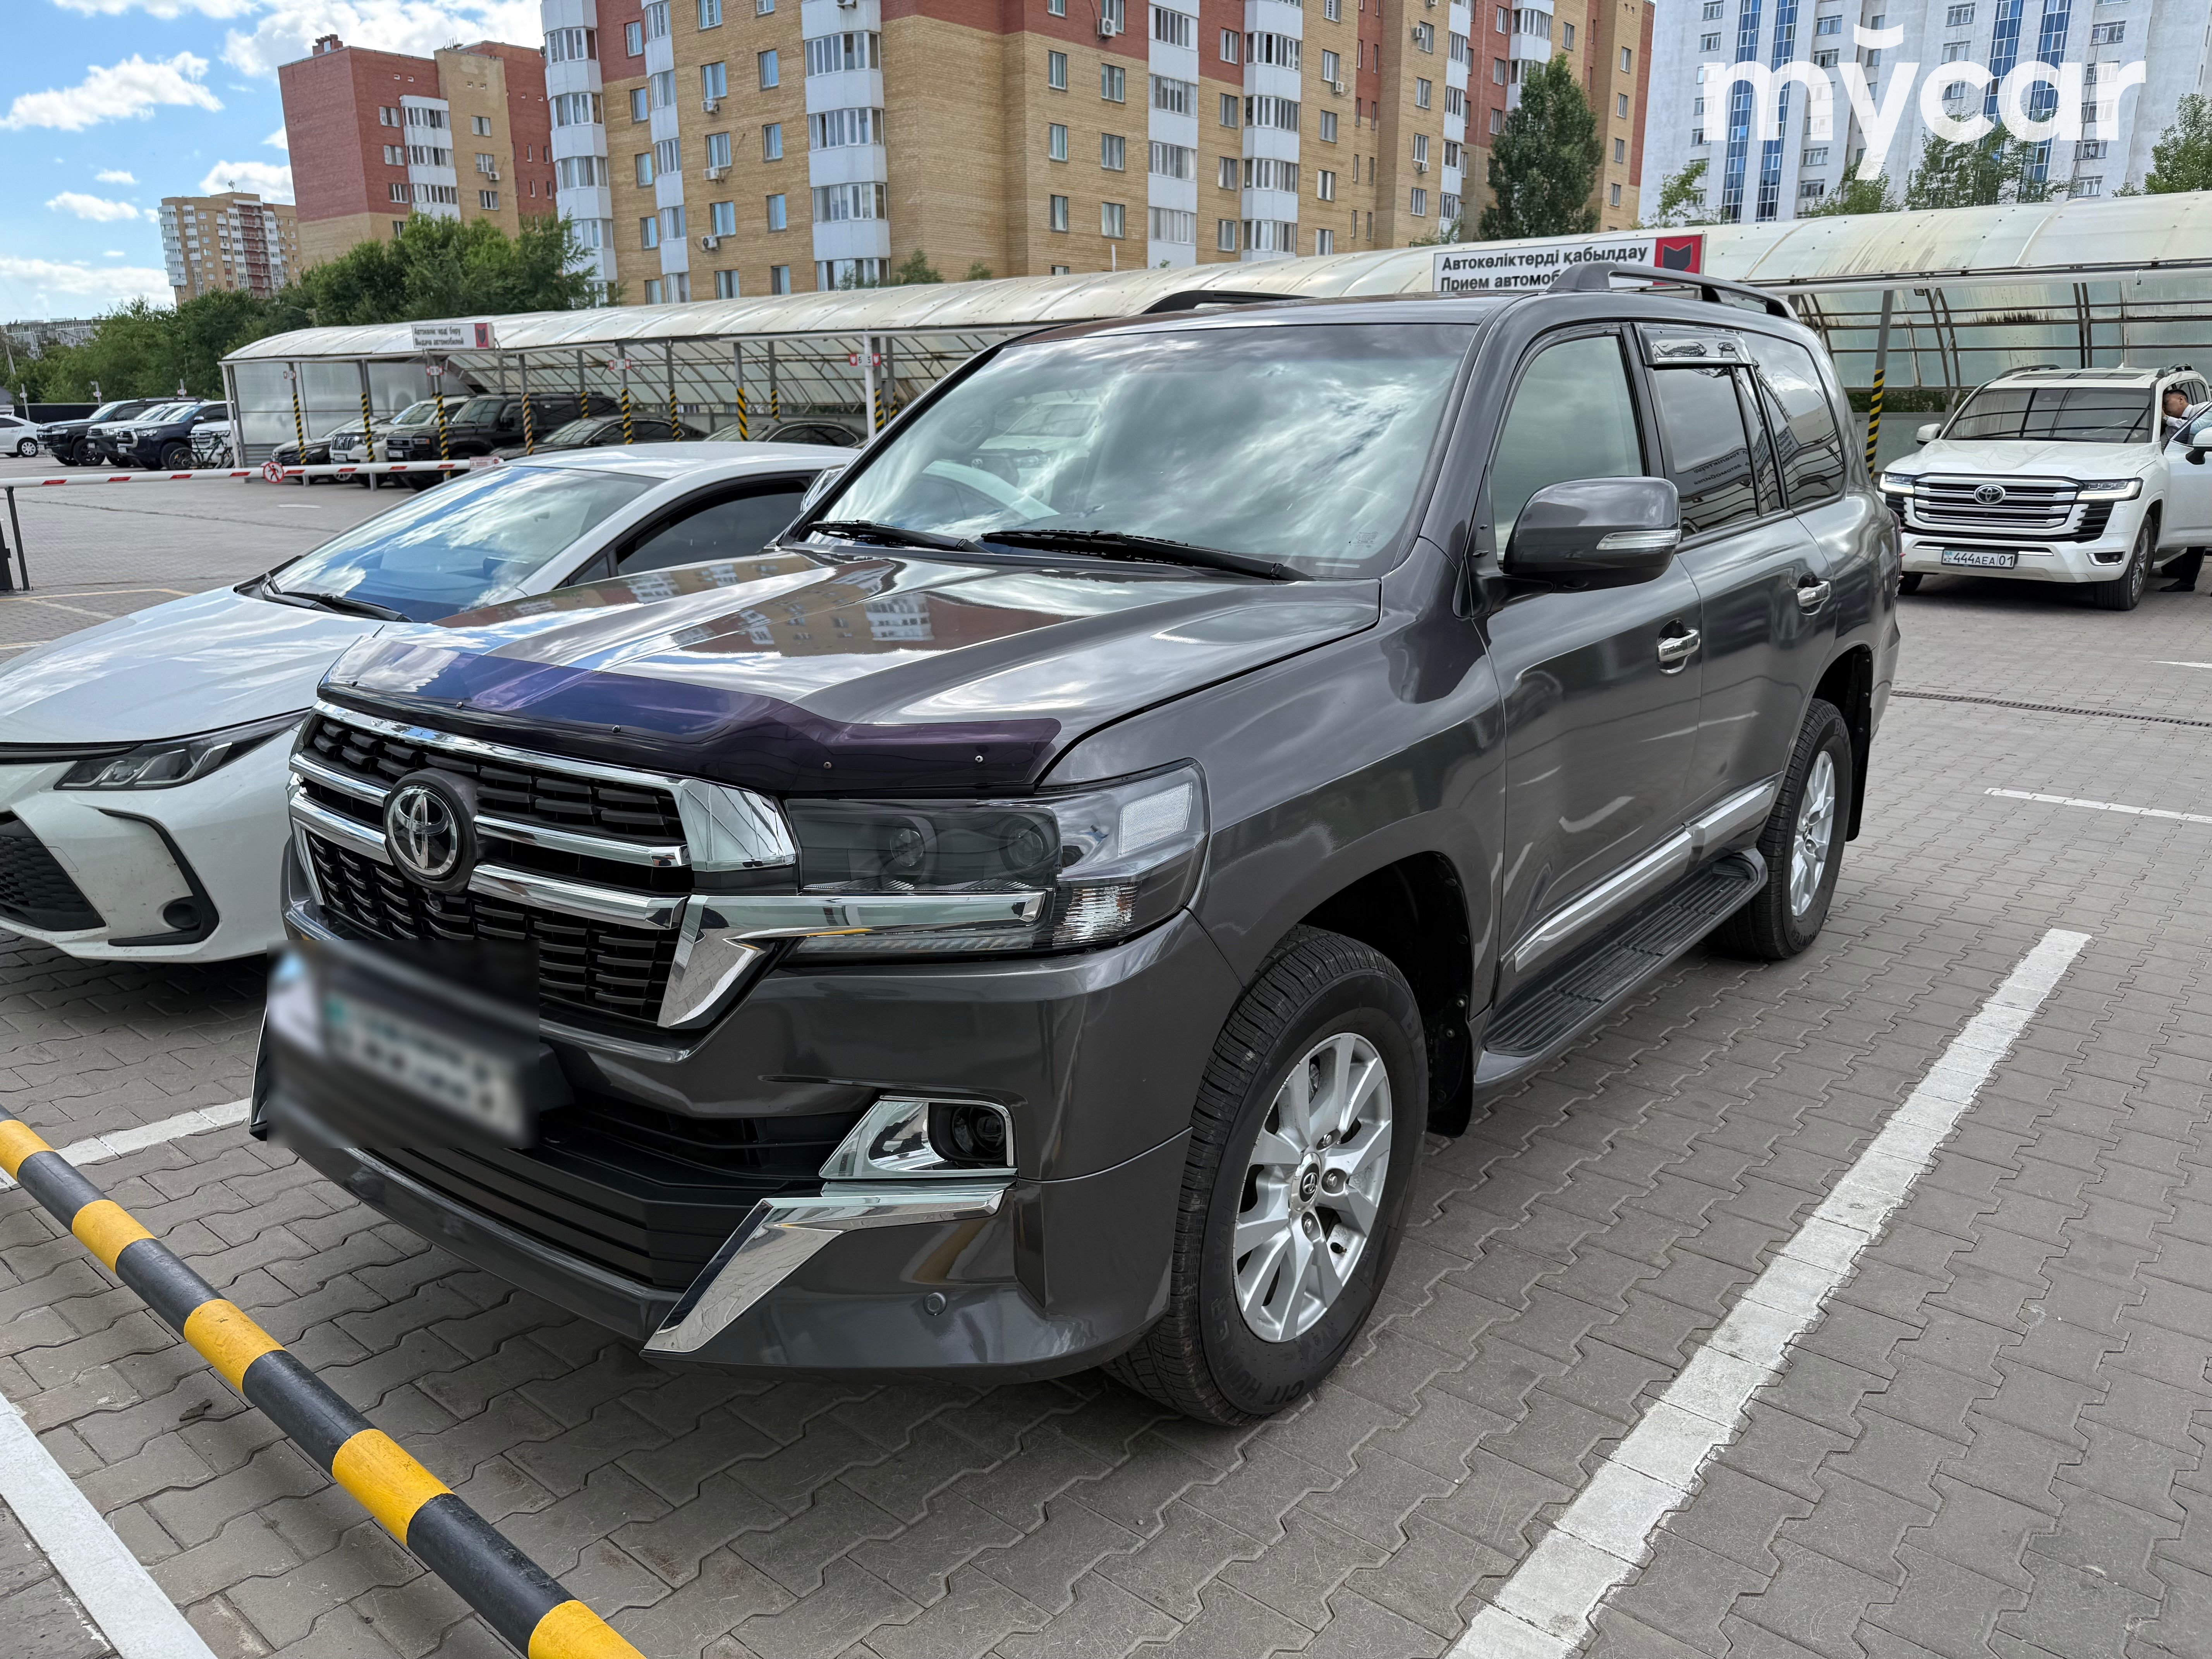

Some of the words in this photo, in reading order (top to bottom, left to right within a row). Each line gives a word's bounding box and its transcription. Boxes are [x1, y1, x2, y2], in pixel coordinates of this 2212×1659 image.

[1442, 250, 1559, 270] Автокөліктерді
[1563, 247, 1648, 265] қабылдау
[1441, 276, 1489, 291] Прием
